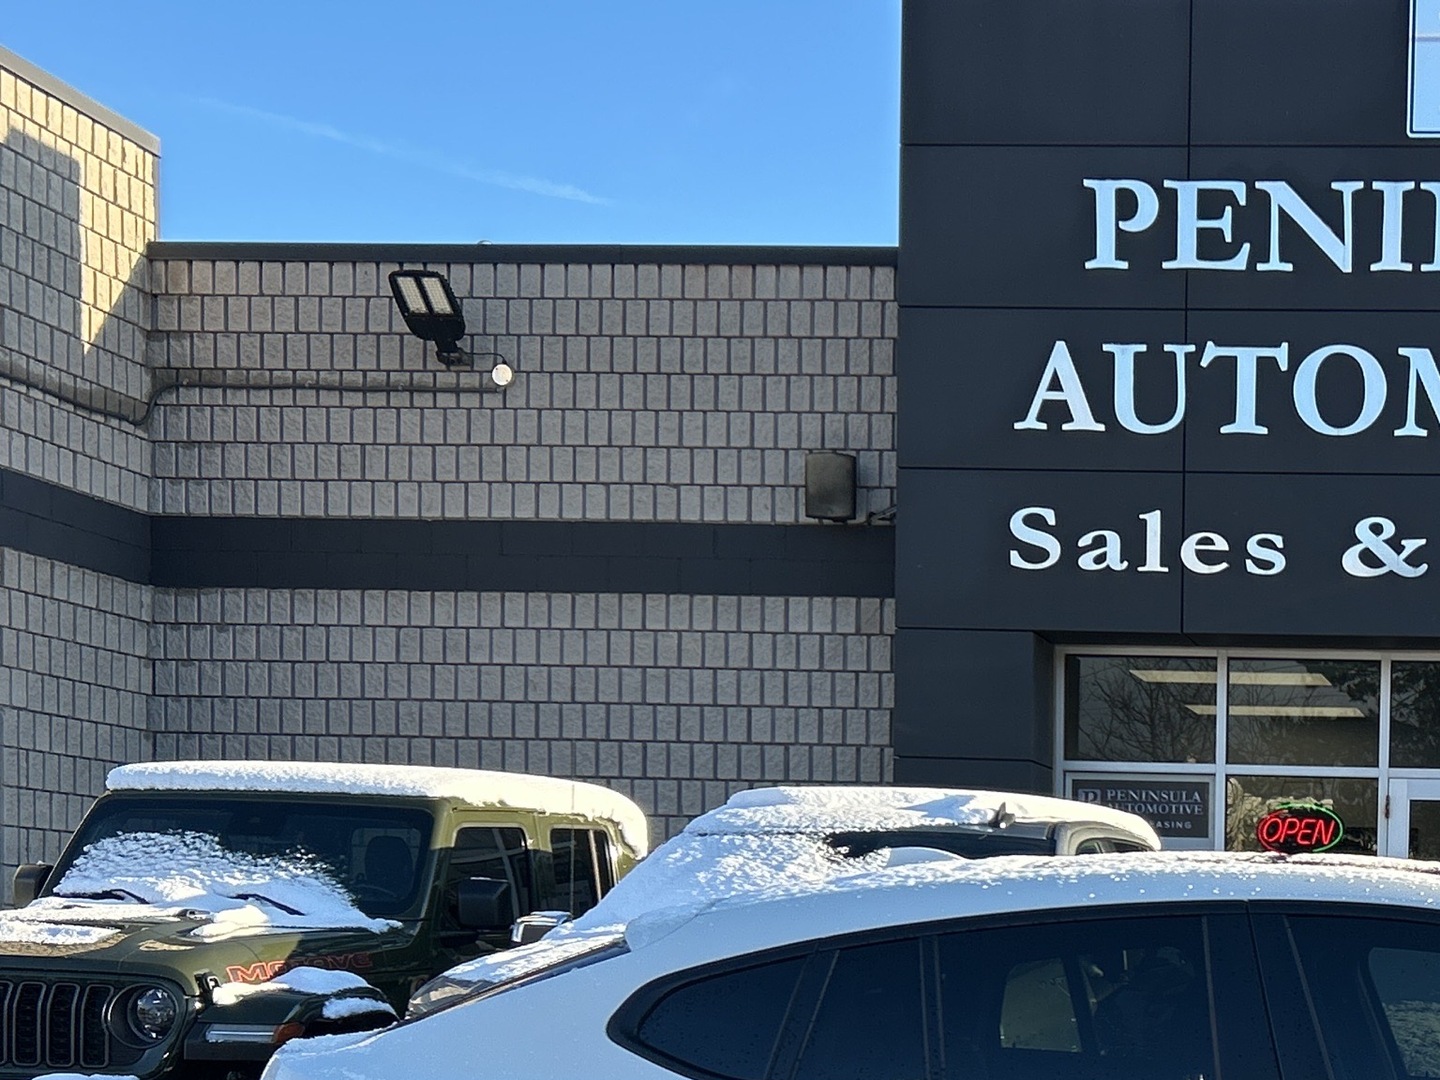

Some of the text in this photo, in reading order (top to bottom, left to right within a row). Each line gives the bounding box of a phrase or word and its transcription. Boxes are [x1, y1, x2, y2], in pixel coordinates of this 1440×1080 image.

[1008, 506, 1287, 575] Sales
[1340, 516, 1430, 578] &
[1106, 789, 1201, 803] PENINSULA
[1262, 818, 1336, 845] OPEN
